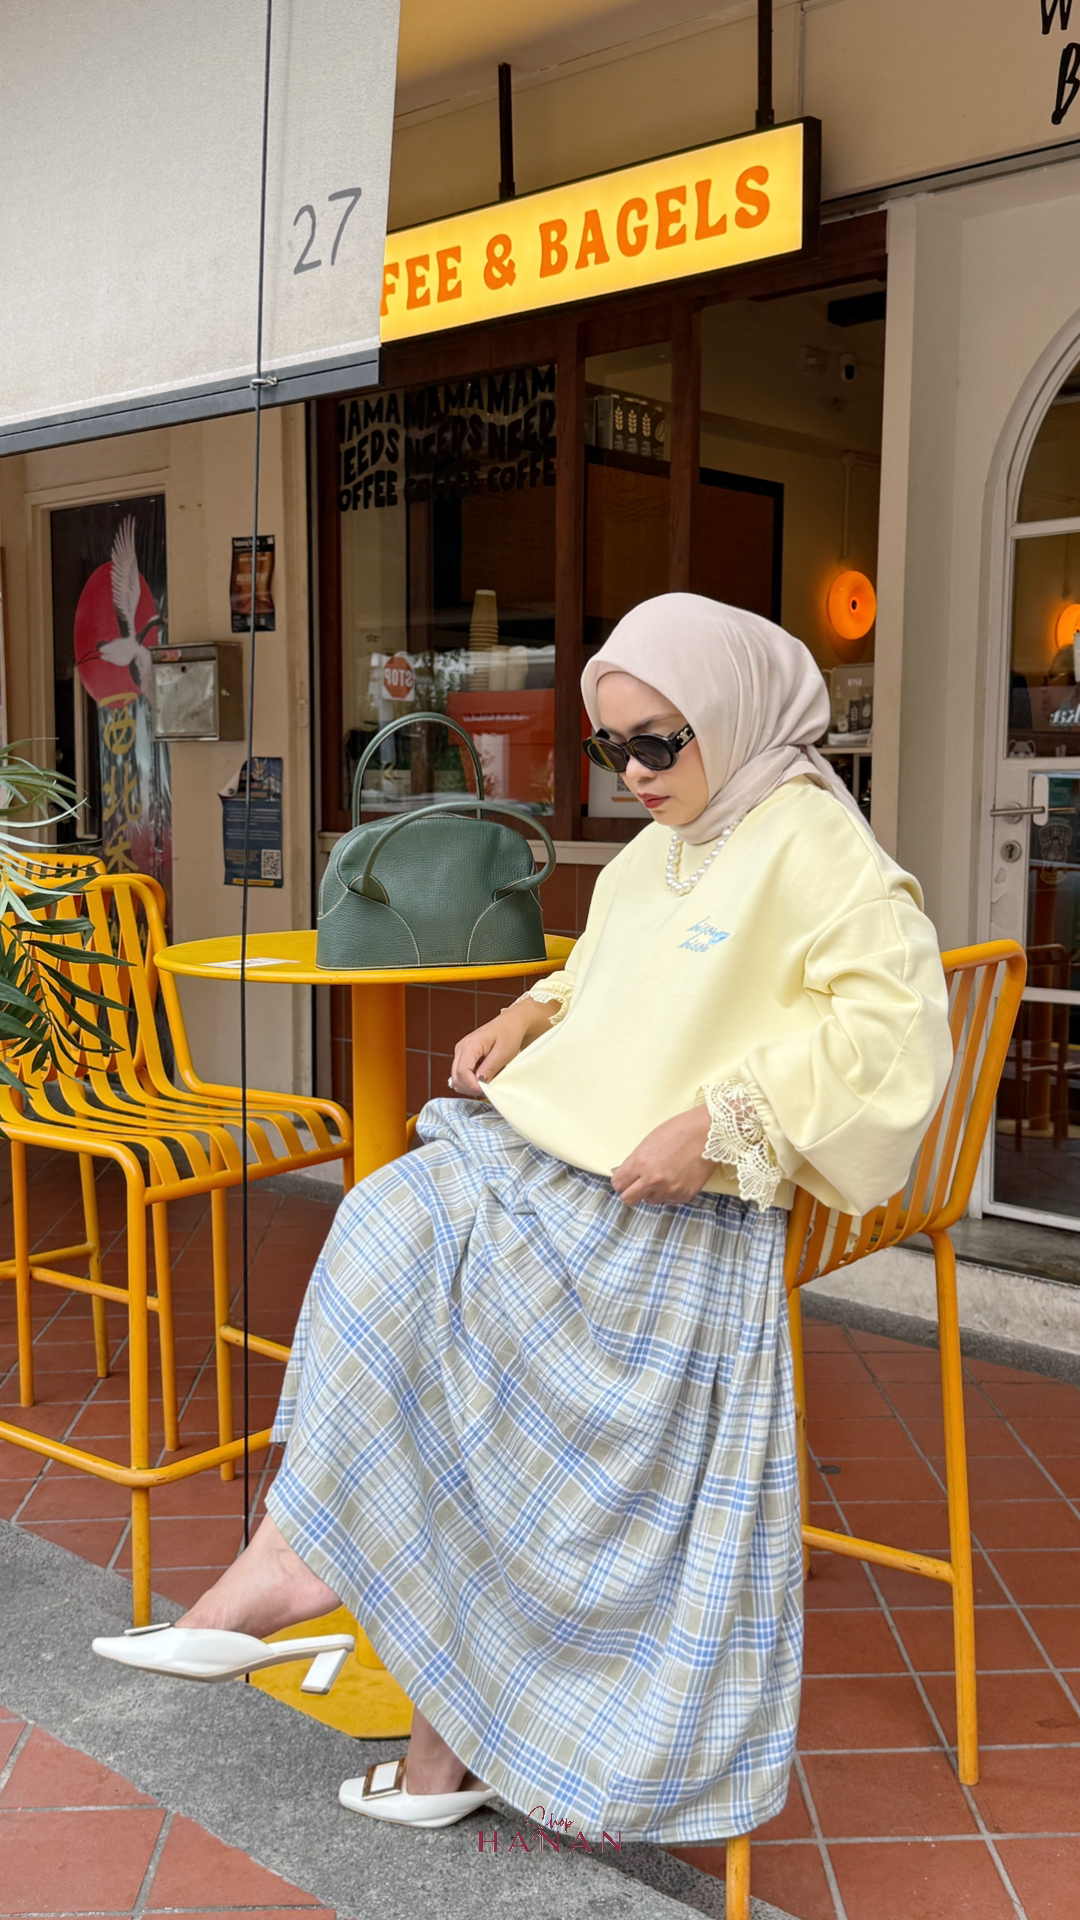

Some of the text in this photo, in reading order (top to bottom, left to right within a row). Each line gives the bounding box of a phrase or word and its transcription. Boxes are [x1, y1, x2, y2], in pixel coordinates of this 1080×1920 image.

[293, 187, 363, 275] 27
[483, 234, 517, 290] &
[539, 165, 770, 279] BAGELS
[338, 428, 399, 486] EEDS
